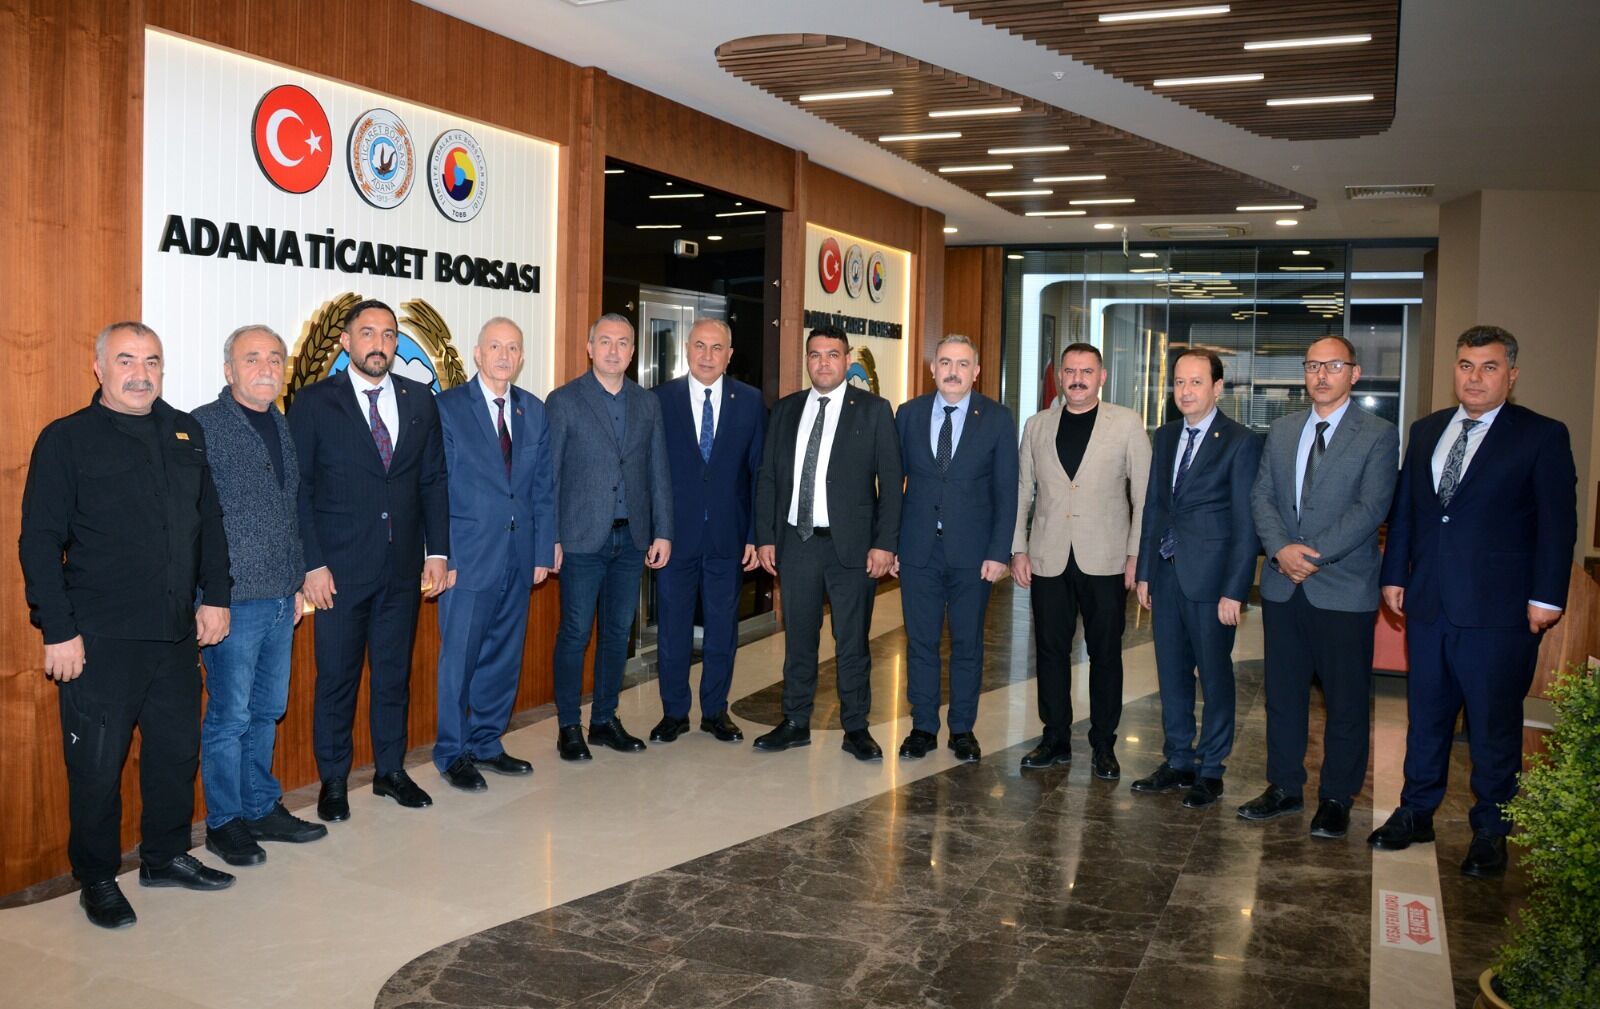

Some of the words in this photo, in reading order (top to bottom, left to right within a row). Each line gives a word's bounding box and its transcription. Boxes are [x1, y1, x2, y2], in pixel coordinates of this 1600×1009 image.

[371, 178, 397, 192] ADANA
[158, 214, 303, 266] ADANA
[305, 228, 428, 280] TİCARET
[435, 251, 541, 294] BORSASI
